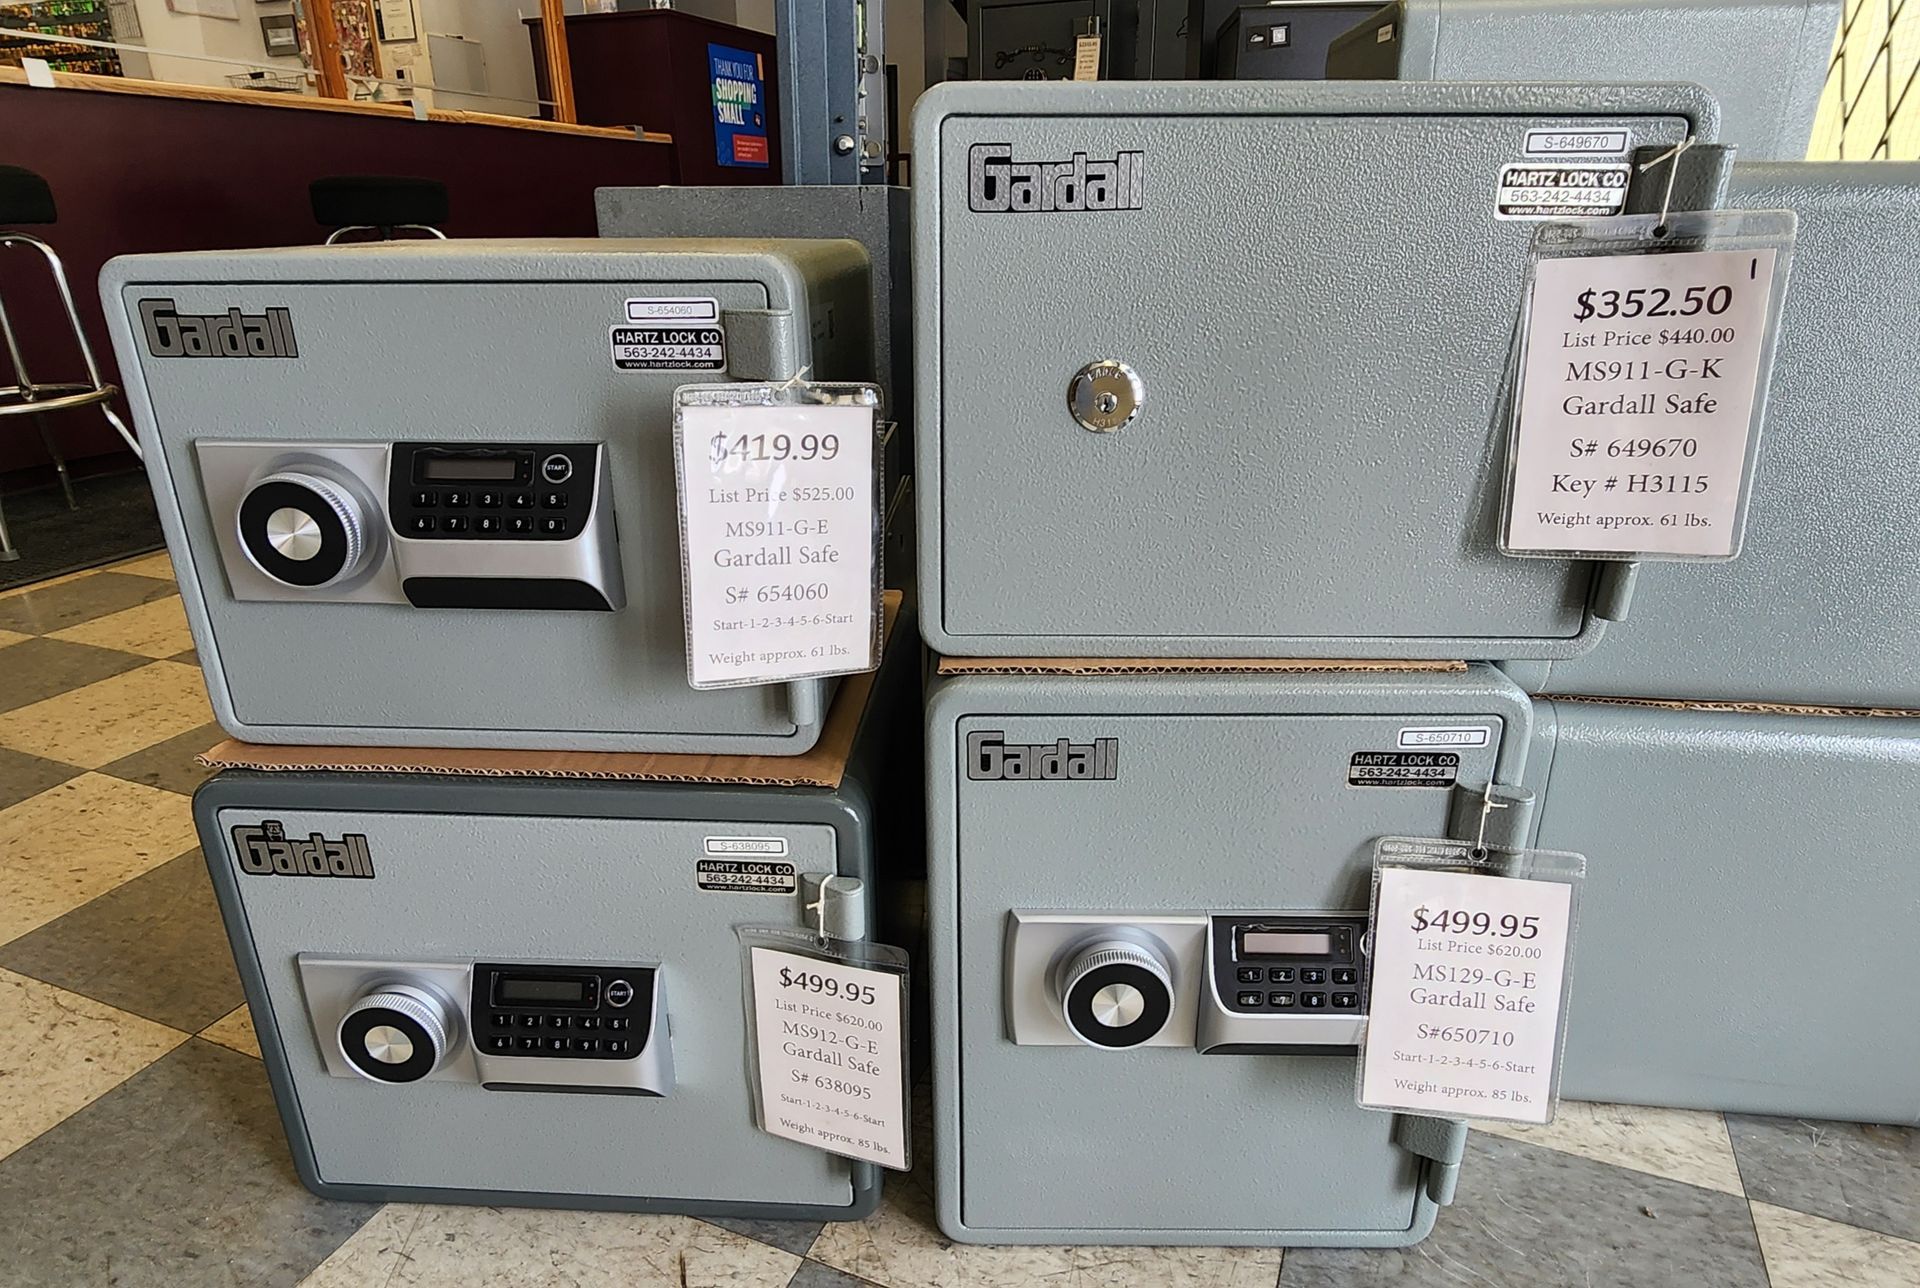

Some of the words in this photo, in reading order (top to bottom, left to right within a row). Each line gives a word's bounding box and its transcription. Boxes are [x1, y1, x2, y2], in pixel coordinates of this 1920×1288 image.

[714, 58, 732, 77] THANK
[731, 62, 743, 79] YOU
[743, 64, 754, 80] FOR
[716, 78, 756, 104] SHOPPING
[718, 102, 745, 125] SMALL
[1544, 136, 1609, 149] S-649670
[968, 143, 1144, 213] Gardall
[1506, 171, 1557, 187] HARTZ
[1558, 171, 1599, 187] LOCK
[1602, 172, 1627, 187] CO.
[1510, 190, 1611, 204] 563-242-4434
[1508, 206, 1610, 216] www.hartzlock.com
[1574, 285, 1733, 323] $352.50
[138, 298, 299, 358] Gardall
[616, 332, 659, 344] HARTZ
[662, 332, 697, 344] LOCK
[1562, 332, 1596, 349] List
[1603, 330, 1652, 347] Price
[1658, 327, 1735, 346] $440.00
[624, 347, 712, 358] 563-242-4434
[625, 361, 715, 369] www.hartzlock.com
[1564, 357, 1724, 382] MS911-G-K
[1563, 393, 1656, 416] Gardall
[1665, 392, 1718, 415] Safe
[709, 431, 840, 465] $419.99
[1570, 438, 1598, 458] S#
[1607, 438, 1698, 458] 649670
[709, 488, 739, 503] List
[746, 488, 787, 503] Prie
[793, 486, 854, 502] $525.00
[1551, 474, 1597, 498] Key
[1604, 475, 1618, 493] #
[1627, 474, 1709, 494] H3115
[420, 494, 426, 503] 1
[452, 494, 458, 504] 2
[484, 495, 491, 504] 3
[517, 495, 523, 505] 4
[550, 495, 556, 504] 5
[418, 519, 424, 528] 6
[450, 519, 457, 528] 7
[483, 519, 489, 529] 8
[516, 519, 522, 529] 9
[549, 520, 555, 529] 0
[726, 519, 829, 537] MS911-G-E
[1537, 512, 1591, 529] Weight
[1596, 515, 1654, 530] approx.
[1660, 514, 1677, 526] 61
[1684, 512, 1712, 528] lbs.
[714, 547, 791, 568] Gardall
[799, 544, 840, 565] Safe
[725, 586, 749, 604] S#
[757, 582, 829, 602] 654060
[713, 614, 854, 632] Start-1-2-3-4-5-6-Start
[709, 651, 755, 667] Weight
[759, 649, 807, 664] approx.
[811, 646, 824, 657] 61
[829, 644, 850, 656] lbs.
[1415, 733, 1472, 743] S-650710
[966, 730, 1118, 781] Gardall
[1355, 755, 1398, 765] HARTZ
[1401, 756, 1434, 766] LOCK
[1438, 756, 1459, 766] CO.
[1358, 767, 1446, 778] 563-242-4434
[231, 825, 375, 879] Gardall
[720, 841, 770, 851] S-638095
[700, 862, 738, 872] HARTZ
[741, 863, 772, 874] LOCK
[775, 865, 795, 875] CO.
[706, 874, 785, 885] 563-242-4434
[706, 884, 787, 892] www.hartzlock.com
[1410, 904, 1540, 940] $499.95
[1418, 938, 1442, 951] List
[1447, 940, 1483, 955] Price
[1487, 942, 1542, 960] $620.00
[779, 965, 875, 1005] $499.95
[1248, 971, 1253, 980] 1
[1280, 972, 1286, 980] 2
[1311, 972, 1317, 981] 3
[1342, 972, 1348, 981] 4
[1413, 963, 1537, 990] MS129-G-E
[1248, 996, 1255, 1004] 6
[1280, 996, 1286, 1005] 7
[1311, 996, 1317, 1005] 8
[1342, 997, 1349, 1005] 9
[1410, 987, 1486, 1010] Gardall
[1494, 994, 1536, 1014] Safe
[499, 1016, 504, 1024] 1
[527, 1017, 533, 1025] 2
[556, 1018, 561, 1026] 3
[584, 1019, 590, 1027] 4
[613, 1020, 619, 1028] 5
[775, 998, 797, 1013] List
[801, 1004, 832, 1021] Price
[836, 1011, 883, 1032] $620.00
[497, 1039, 503, 1047] 6
[526, 1040, 532, 1048] 7
[554, 1040, 560, 1049] 8
[583, 1041, 589, 1050] 9
[612, 1042, 618, 1051] 0
[782, 1020, 879, 1055] MS912-G-E
[1416, 1023, 1514, 1047] S#650710
[782, 1041, 842, 1067] Gardall
[848, 1057, 881, 1077] Safe
[1392, 1050, 1535, 1075] Start-1-2-3-4-5-6-Start
[791, 1069, 809, 1084] S#
[815, 1075, 871, 1100] 638095
[1394, 1078, 1437, 1095] Weight
[1441, 1083, 1488, 1099] approx.
[1491, 1089, 1507, 1101] 85
[1511, 1090, 1532, 1104] lbs.
[780, 1093, 886, 1128] Start-1-2-3-4-5-6-Start
[779, 1117, 814, 1135] Weight
[817, 1129, 855, 1145] approx.
[858, 1138, 870, 1149] 85
[873, 1141, 891, 1154] lbs.
